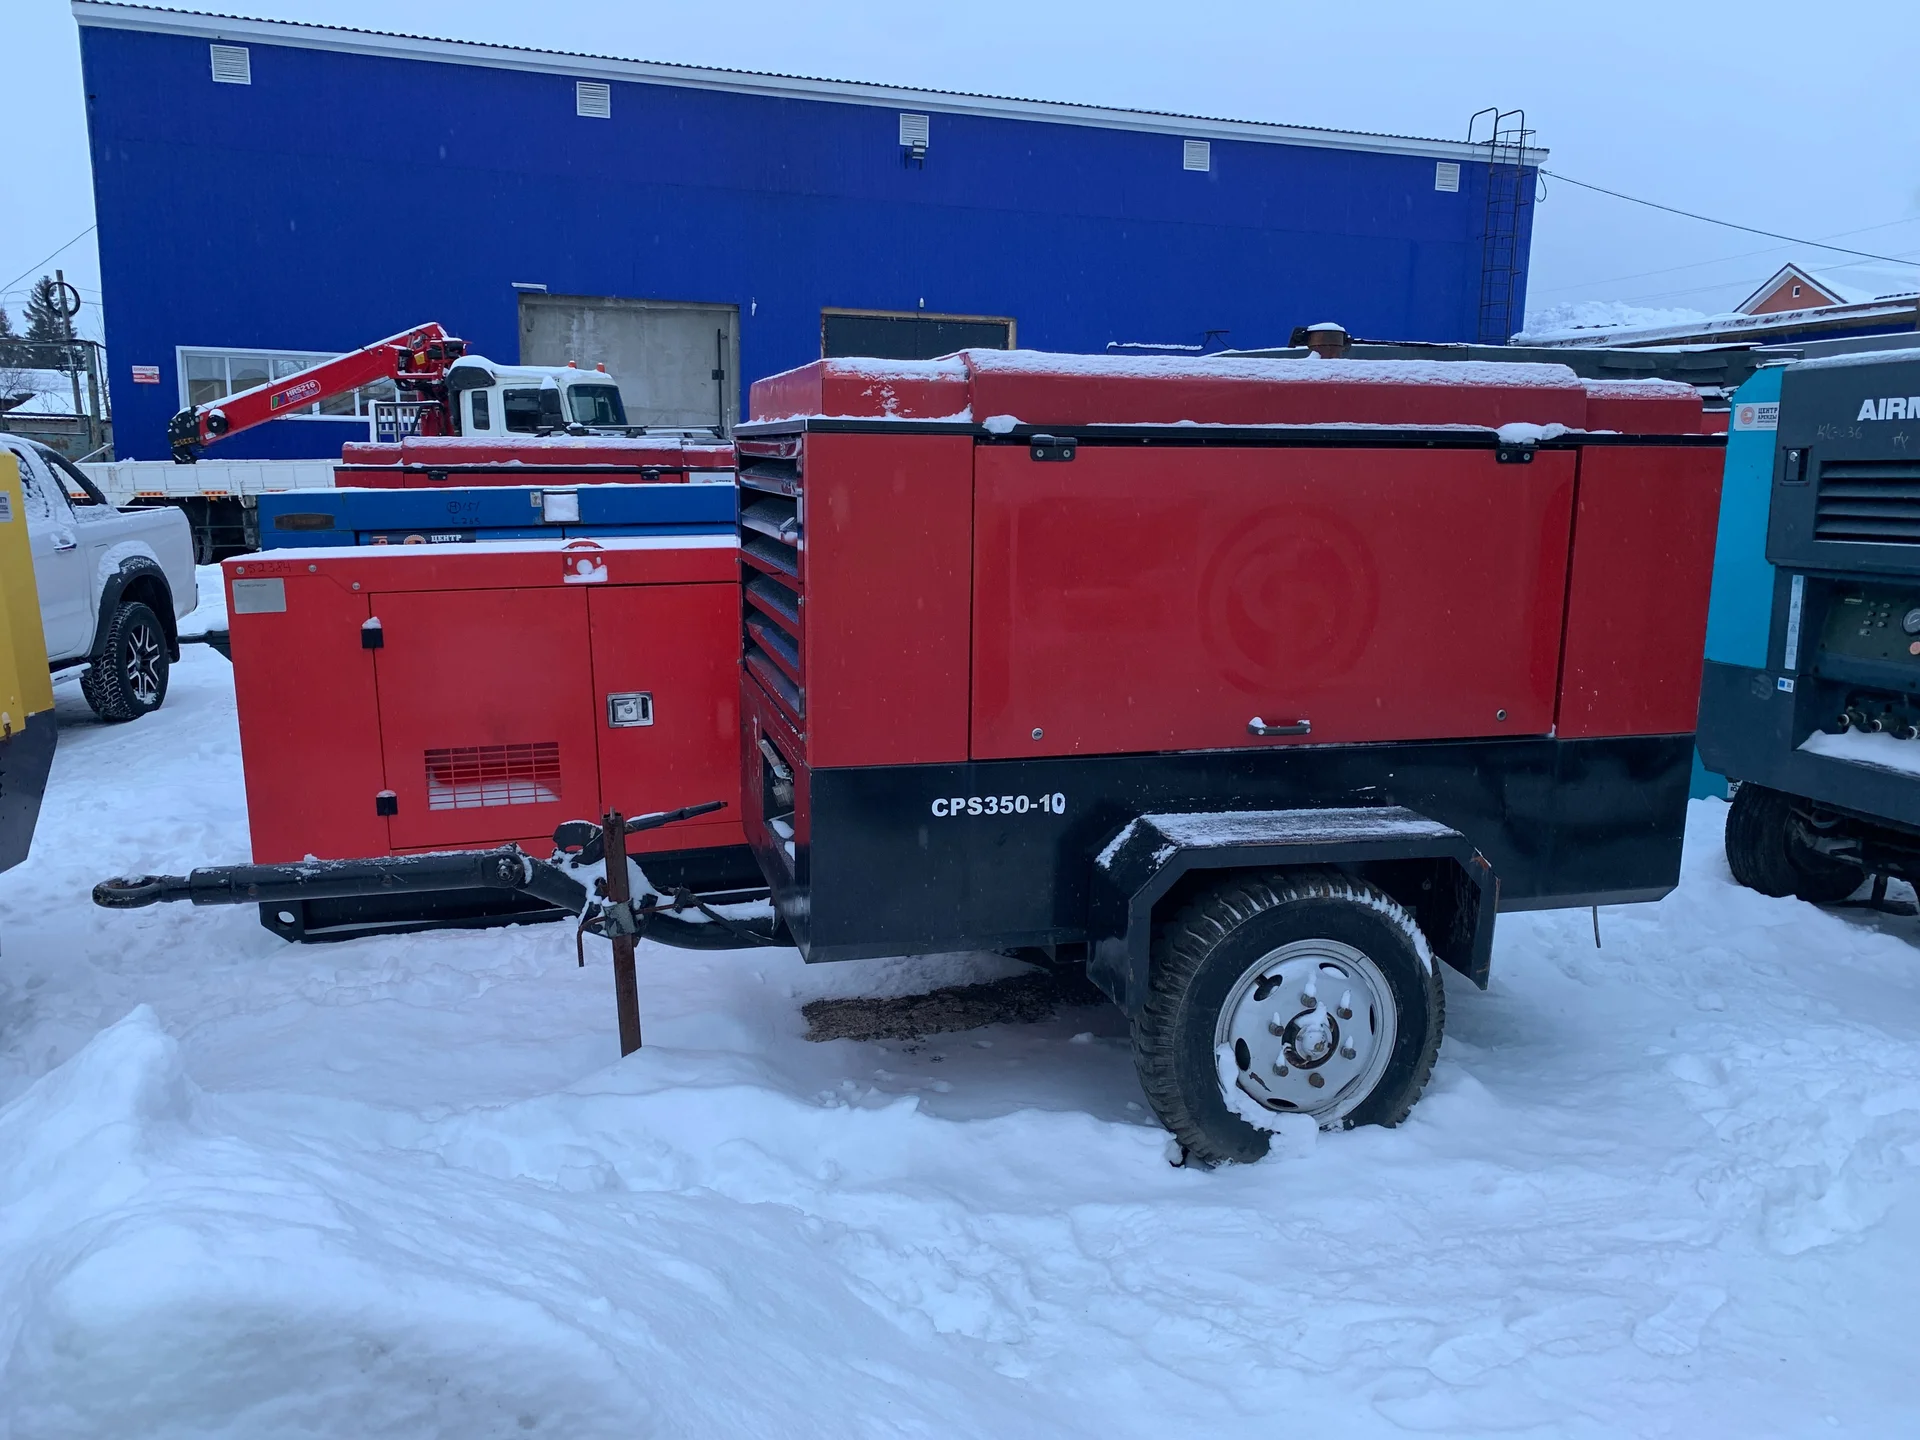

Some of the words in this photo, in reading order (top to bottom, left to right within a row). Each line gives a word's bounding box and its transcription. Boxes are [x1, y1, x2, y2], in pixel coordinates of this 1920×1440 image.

[286, 381, 316, 397] HRS216
[431, 534, 462, 543] ЦЕНТР
[931, 792, 1066, 816] CPS350-10
